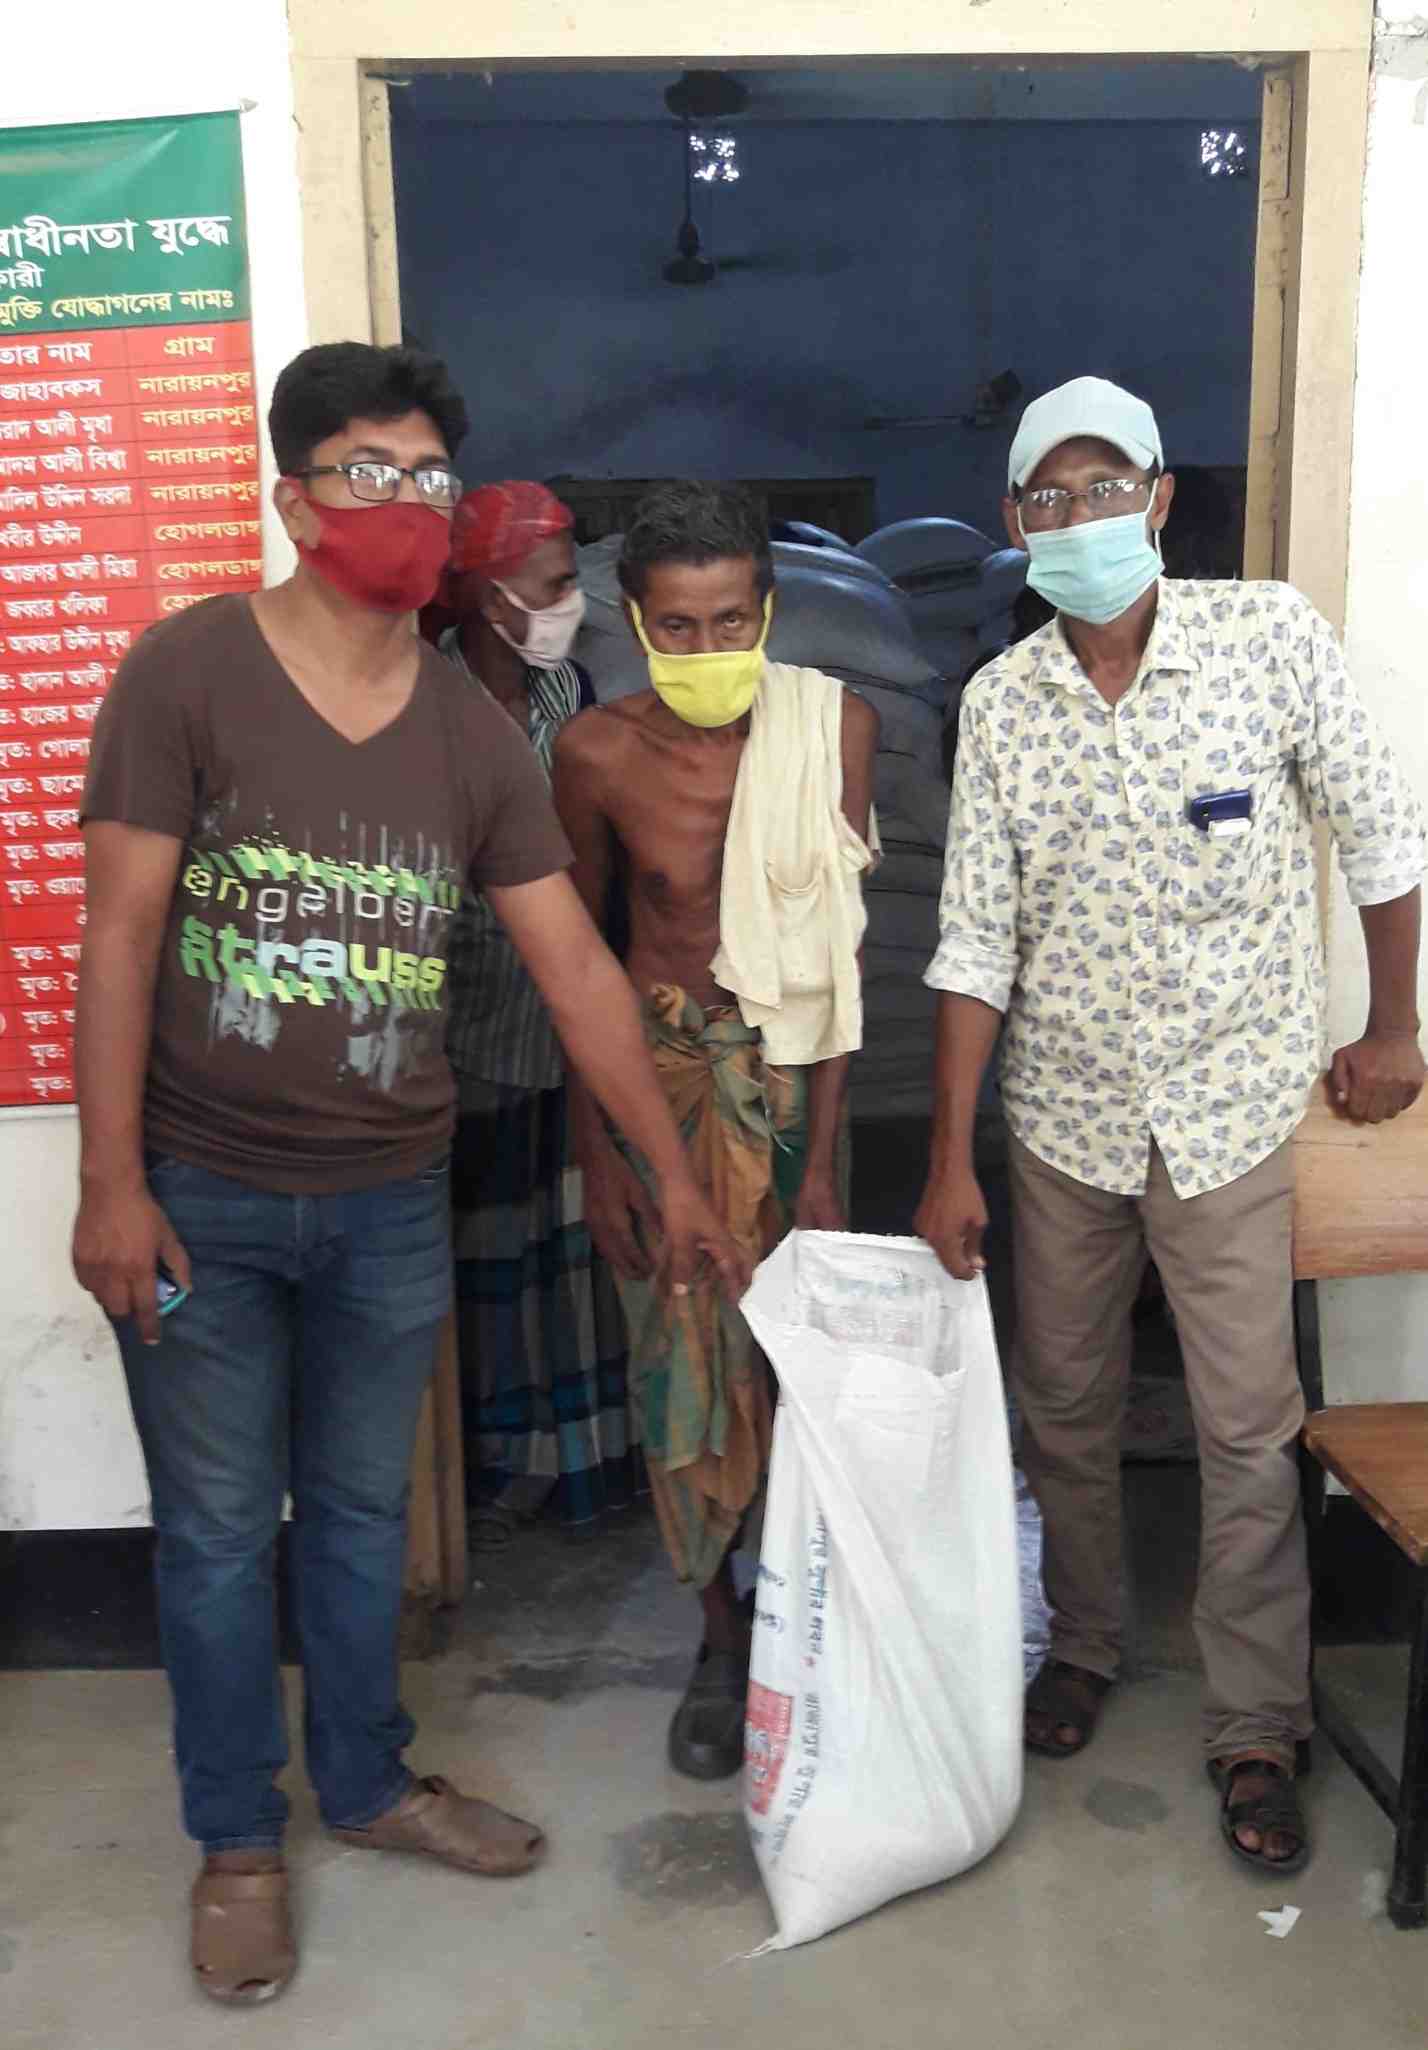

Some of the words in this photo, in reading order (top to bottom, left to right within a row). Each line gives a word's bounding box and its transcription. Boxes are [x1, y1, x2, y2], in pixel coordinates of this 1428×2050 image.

[146, 216, 232, 256] যুদ্ধে
[51, 292, 173, 319] যোদ্ধাগনের
[0, 345, 40, 366] তার
[47, 341, 93, 362] নাম
[163, 335, 216, 357] গ্রাম
